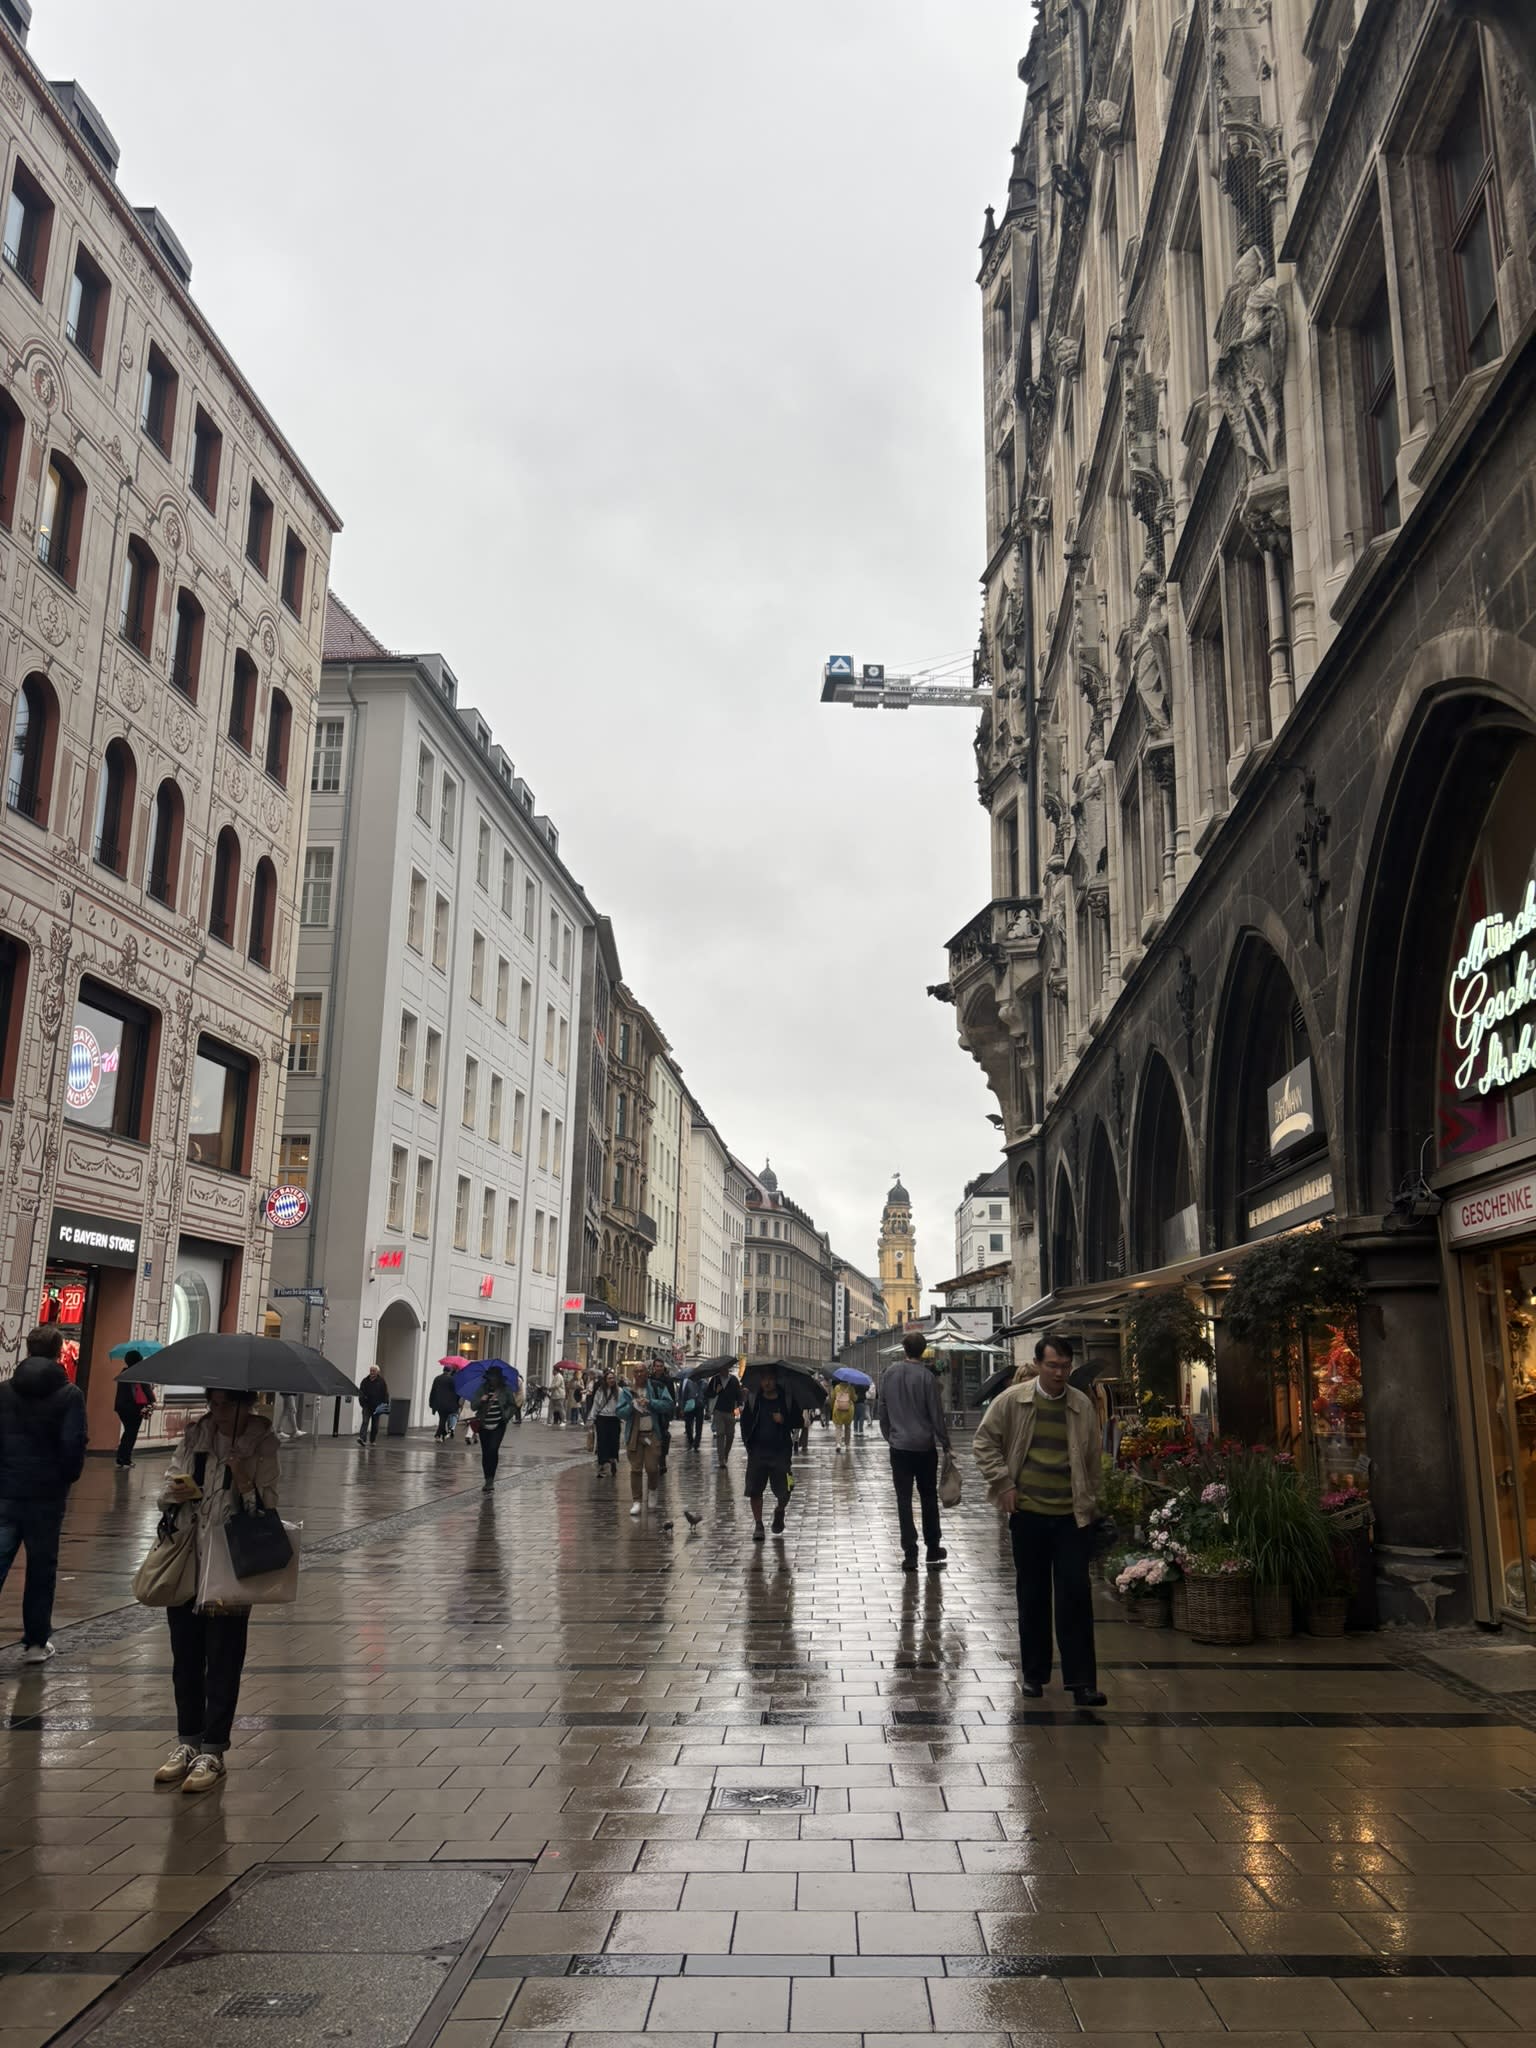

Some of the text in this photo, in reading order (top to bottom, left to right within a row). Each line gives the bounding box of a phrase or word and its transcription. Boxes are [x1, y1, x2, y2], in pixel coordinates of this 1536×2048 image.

[66, 1080, 97, 1105] NCHEN
[280, 1187, 306, 1204] BAYERN
[1461, 1186, 1533, 1227] GESCHENKE
[269, 1210, 304, 1226] MÜNCHEN
[59, 1226, 136, 1253] FC BAYERN STORE
[65, 1292, 81, 1306] 20
